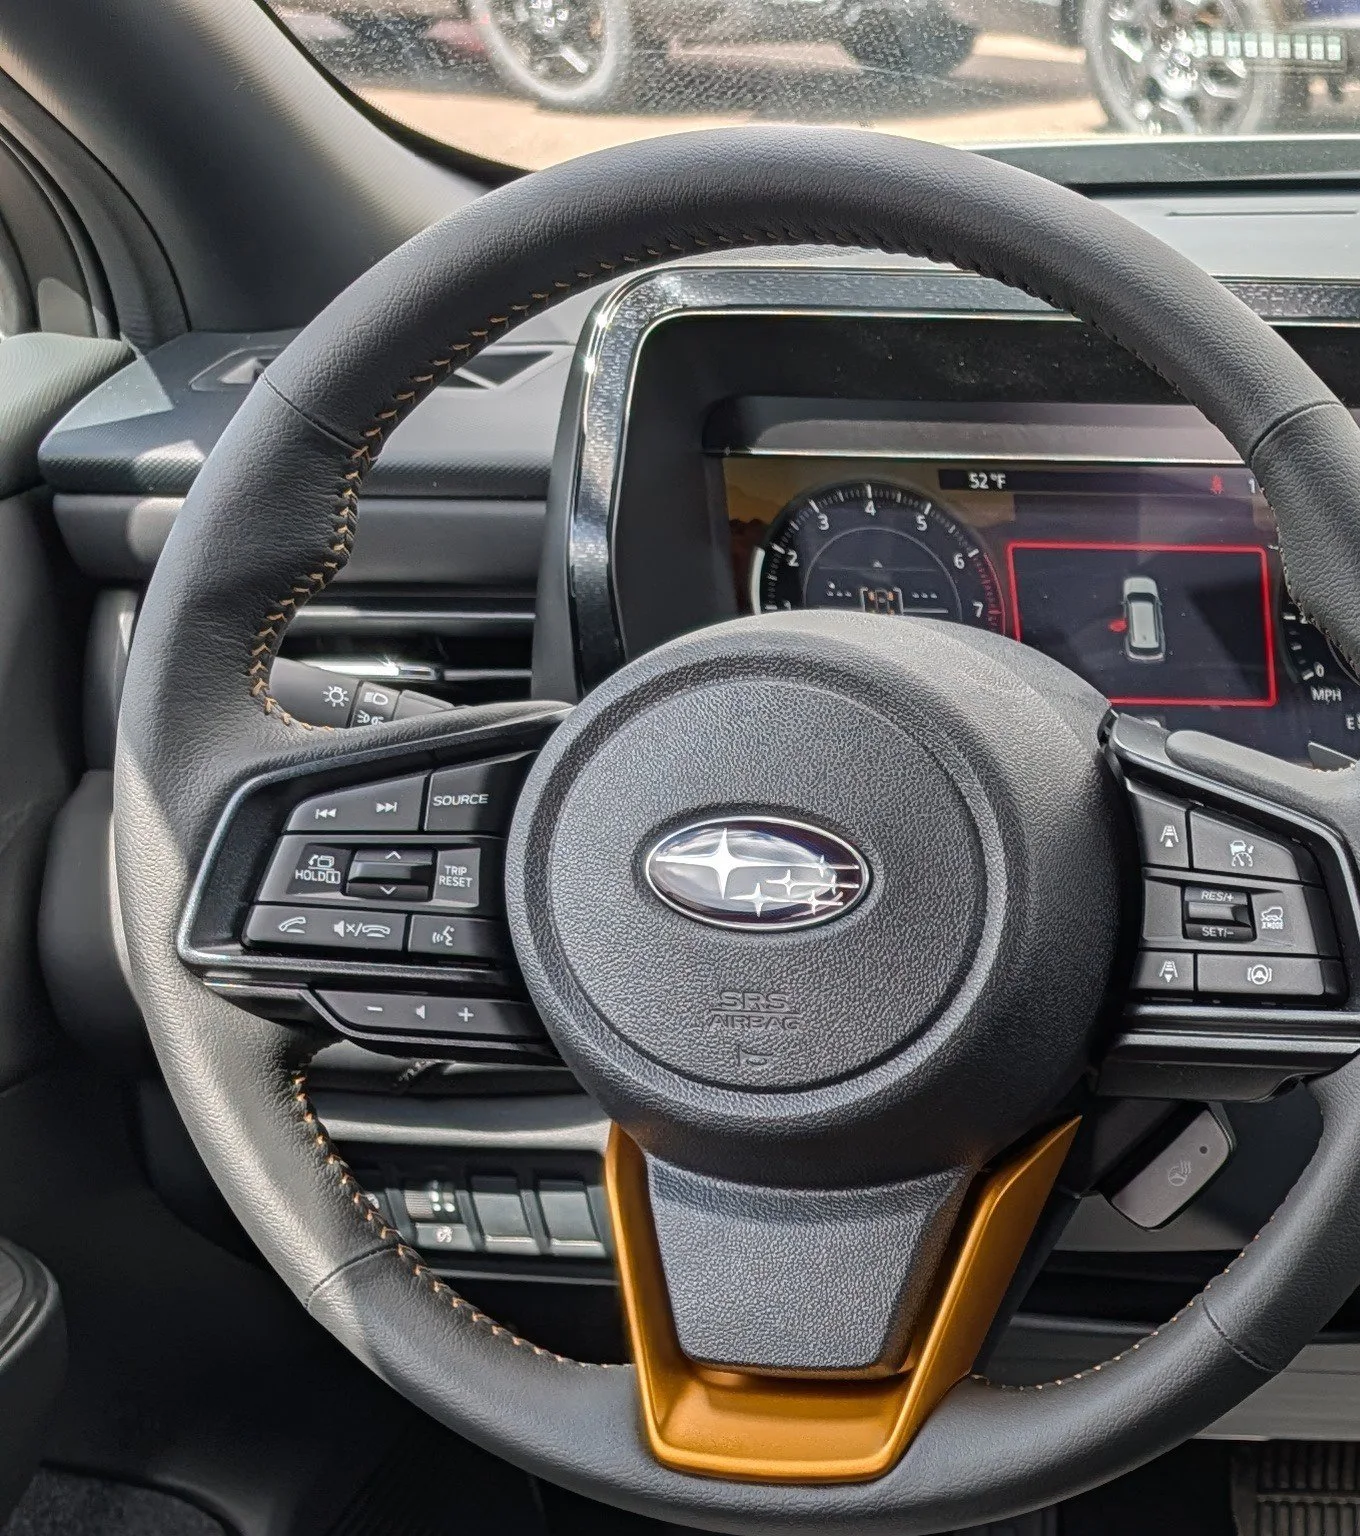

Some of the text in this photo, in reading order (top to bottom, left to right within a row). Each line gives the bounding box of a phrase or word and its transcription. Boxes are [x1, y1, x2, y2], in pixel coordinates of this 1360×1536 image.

[864, 501, 876, 516] 4
[818, 514, 830, 531] 3
[916, 515, 928, 532] 5
[788, 551, 800, 567] 2
[953, 553, 965, 570] 6
[973, 601, 983, 617] 7
[1315, 663, 1324, 677] 0
[1311, 688, 1341, 701] MPH
[433, 793, 489, 806] SOURCE
[444, 865, 467, 877] TRIP
[439, 875, 472, 888] RESET
[1201, 891, 1234, 902] RES/+
[719, 991, 790, 1010] SRS
